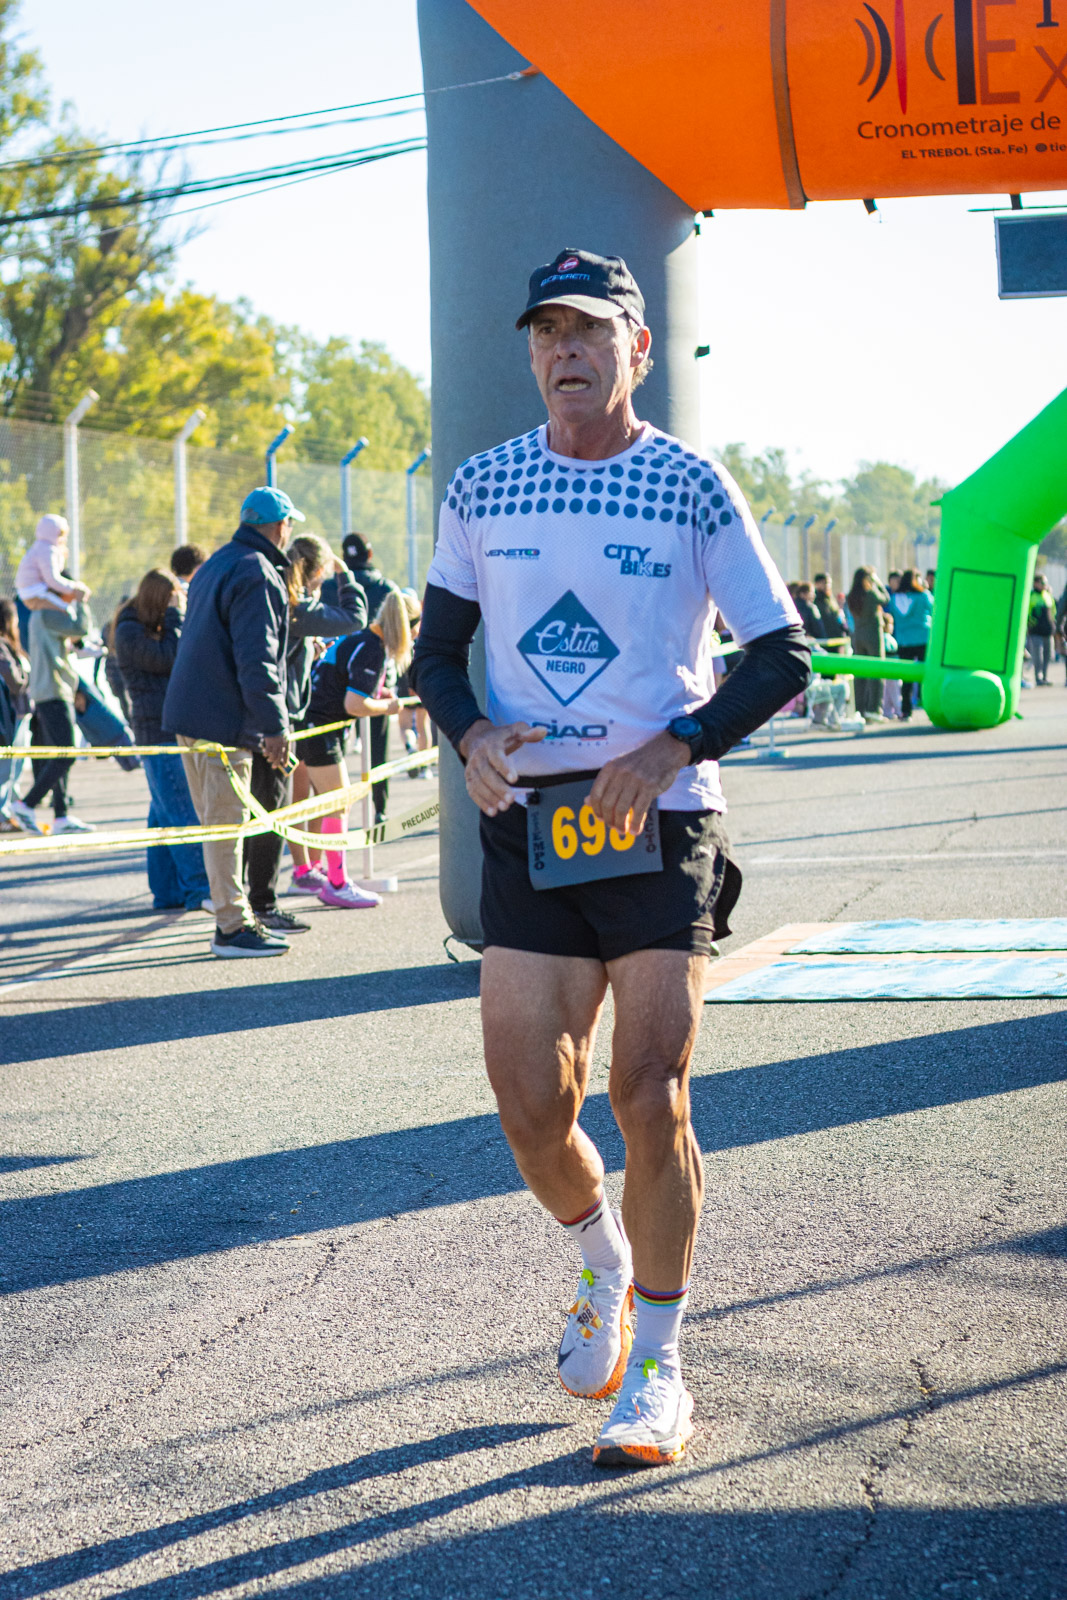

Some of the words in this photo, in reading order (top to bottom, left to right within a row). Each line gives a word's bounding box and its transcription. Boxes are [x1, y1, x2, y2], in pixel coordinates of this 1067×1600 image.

[857, 114, 1024, 139] Cronometraje
[1030, 111, 1061, 131] de
[901, 149, 919, 160] EL
[920, 147, 972, 159] TREBOL
[975, 145, 1005, 157] (Sta.
[1008, 143, 1028, 155] Fe)
[484, 548, 540, 558] VENETO
[603, 543, 652, 562] CITY
[620, 560, 672, 578] BIKES
[535, 620, 600, 654] Estilo
[545, 659, 586, 675] NEGRO
